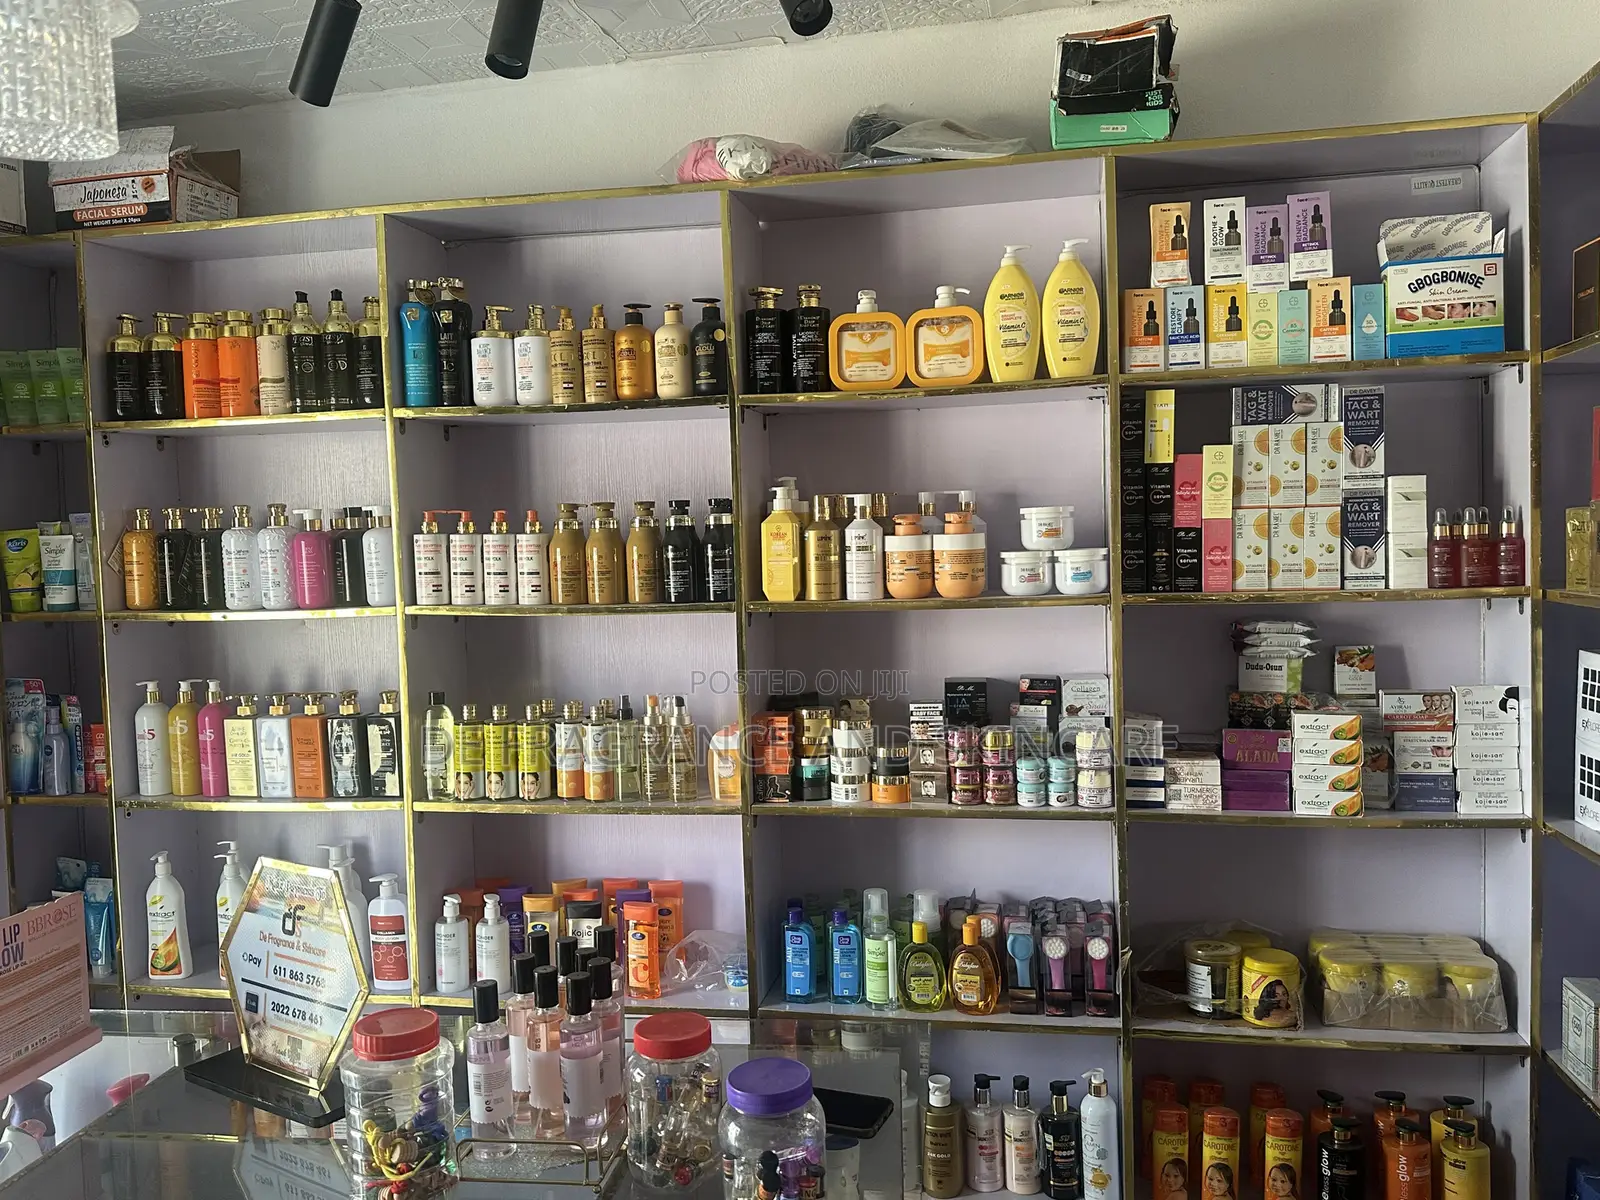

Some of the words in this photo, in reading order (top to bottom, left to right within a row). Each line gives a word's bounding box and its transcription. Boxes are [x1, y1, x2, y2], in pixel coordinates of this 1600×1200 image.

[1145, 90, 1162, 98] JUST
[80, 185, 127, 204] Japonesa
[77, 208, 110, 220] FACIAL
[111, 204, 144, 218] SERUM
[93, 219, 111, 227] WEIGHT
[1407, 270, 1485, 294] GBOGBONISE
[1000, 292, 1025, 300] GARNIER
[1059, 287, 1084, 295] GARNIER
[1429, 288, 1445, 297] Skin
[1447, 286, 1469, 295] Cream
[1057, 318, 1079, 326] Vitamin
[1258, 391, 1267, 421] WART
[1346, 400, 1369, 410] TAG
[1372, 399, 1381, 409] &
[1248, 402, 1256, 422] TAG
[1347, 410, 1380, 420] WART
[1346, 502, 1369, 512] TAG
[1372, 501, 1381, 511] &
[1347, 512, 1380, 521] WART
[44, 547, 65, 555] Simple
[1245, 662, 1283, 672] Dudu-Osun
[3, 923, 20, 946] LIP
[259, 931, 268, 942] De
[571, 929, 592, 938] Kojic
[0, 942, 24, 968] OW
[867, 949, 886, 957] Simple
[273, 964, 287, 979] 611
[289, 970, 304, 984] 863
[271, 1001, 290, 1016] 2022
[291, 1006, 307, 1021] 678
[309, 1011, 323, 1026] 461
[1219, 1117, 1228, 1127] 3
[1283, 1118, 1291, 1127] 3
[1204, 1140, 1237, 1150] CAROTONE
[1267, 1140, 1299, 1152] CAROTONE
[1396, 1154, 1410, 1182] glow
